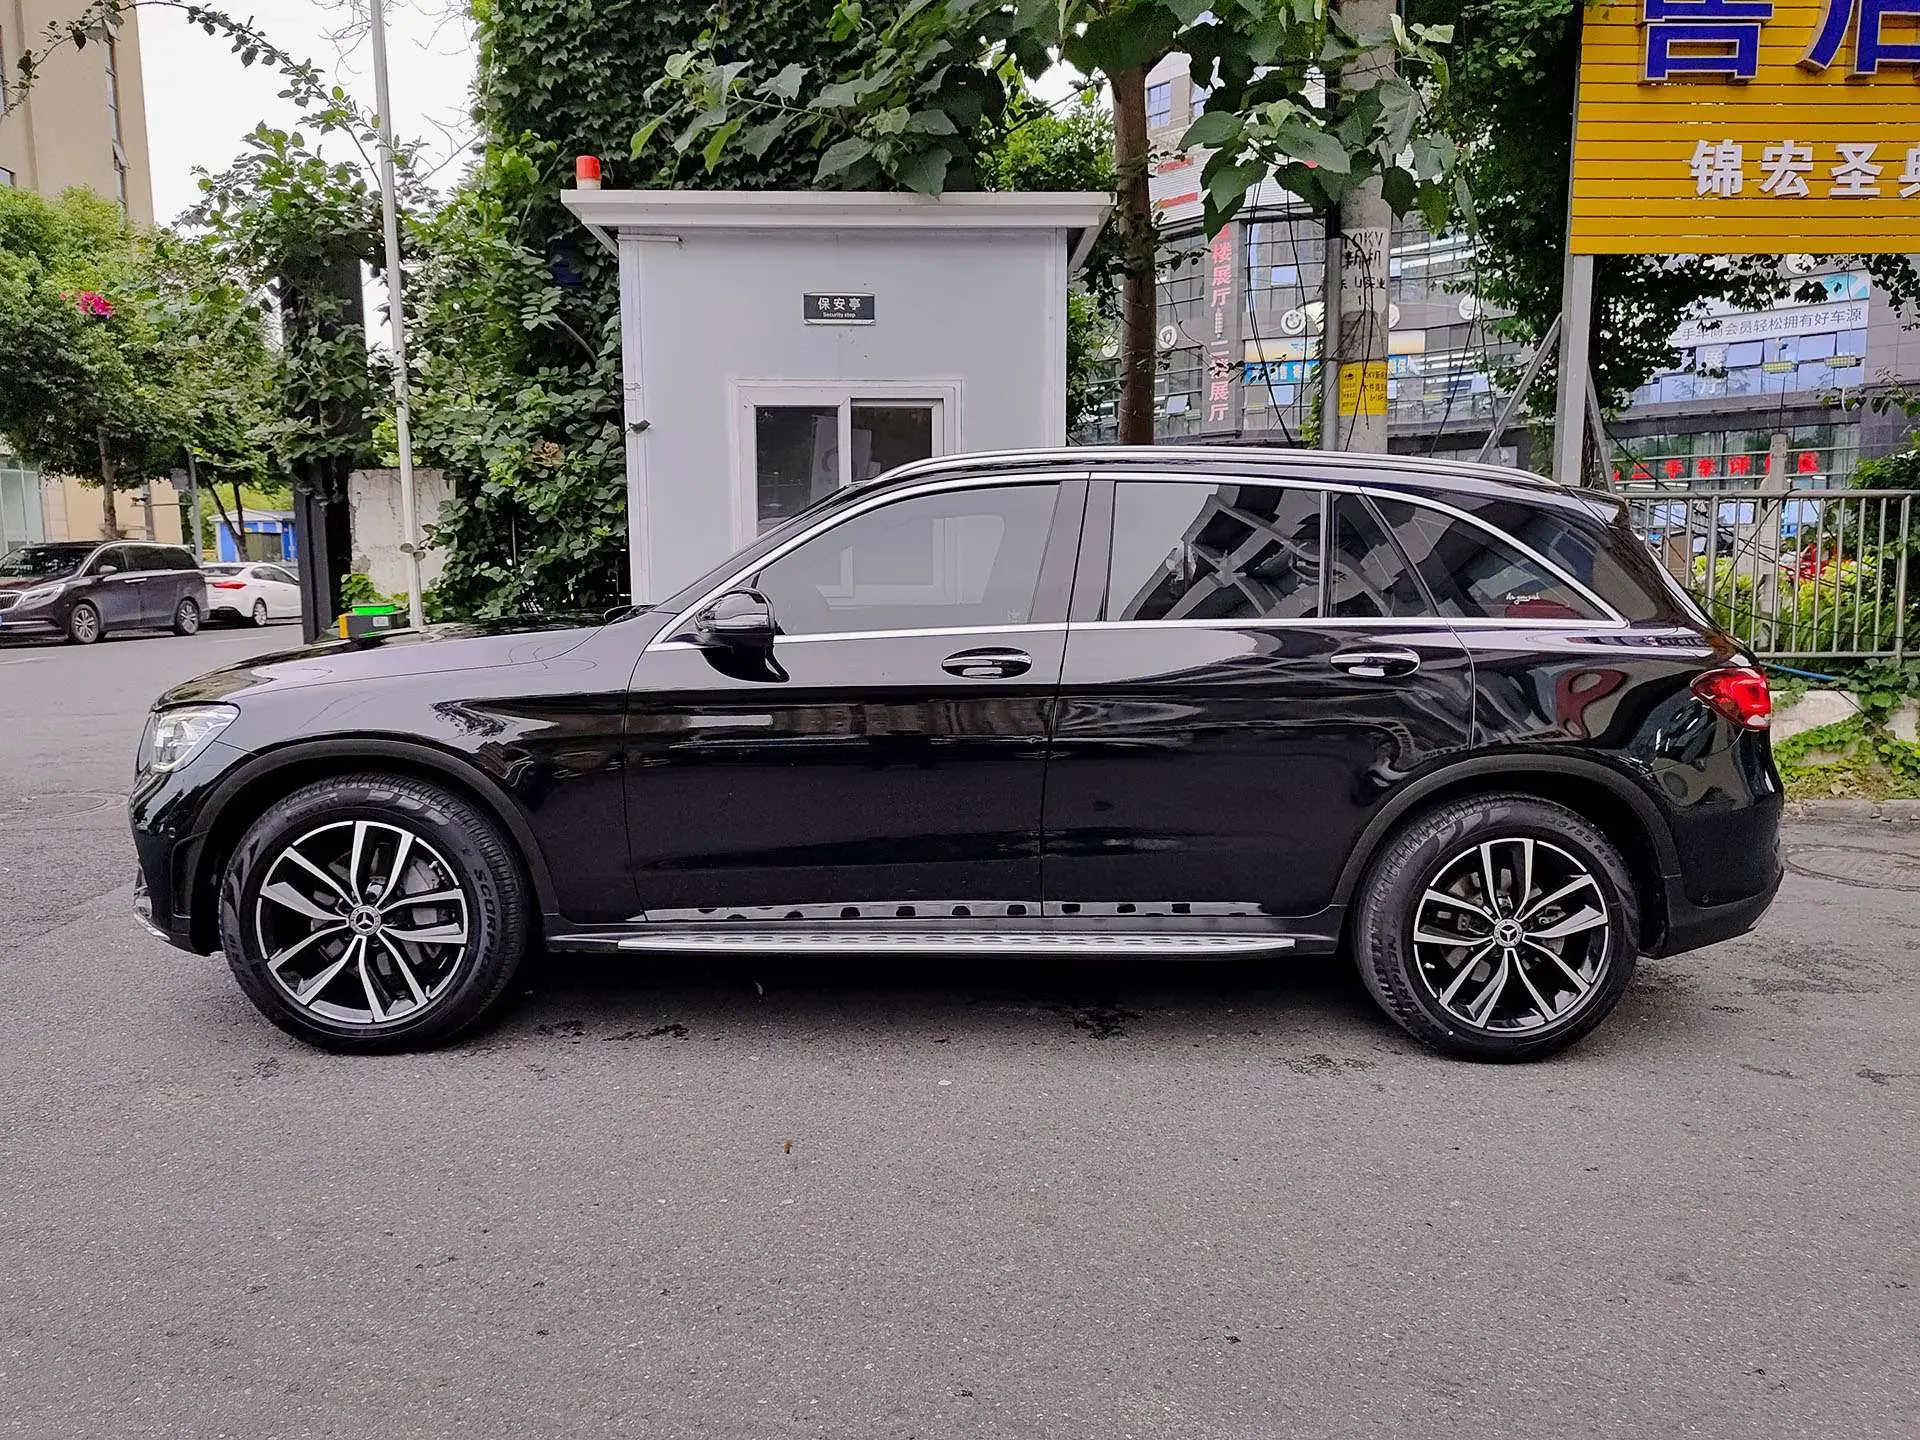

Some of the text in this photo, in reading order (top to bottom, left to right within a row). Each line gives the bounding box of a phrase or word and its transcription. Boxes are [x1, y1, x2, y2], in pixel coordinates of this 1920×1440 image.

[817, 297, 861, 311] 保安亭
[472, 867, 498, 985] SCORPION
